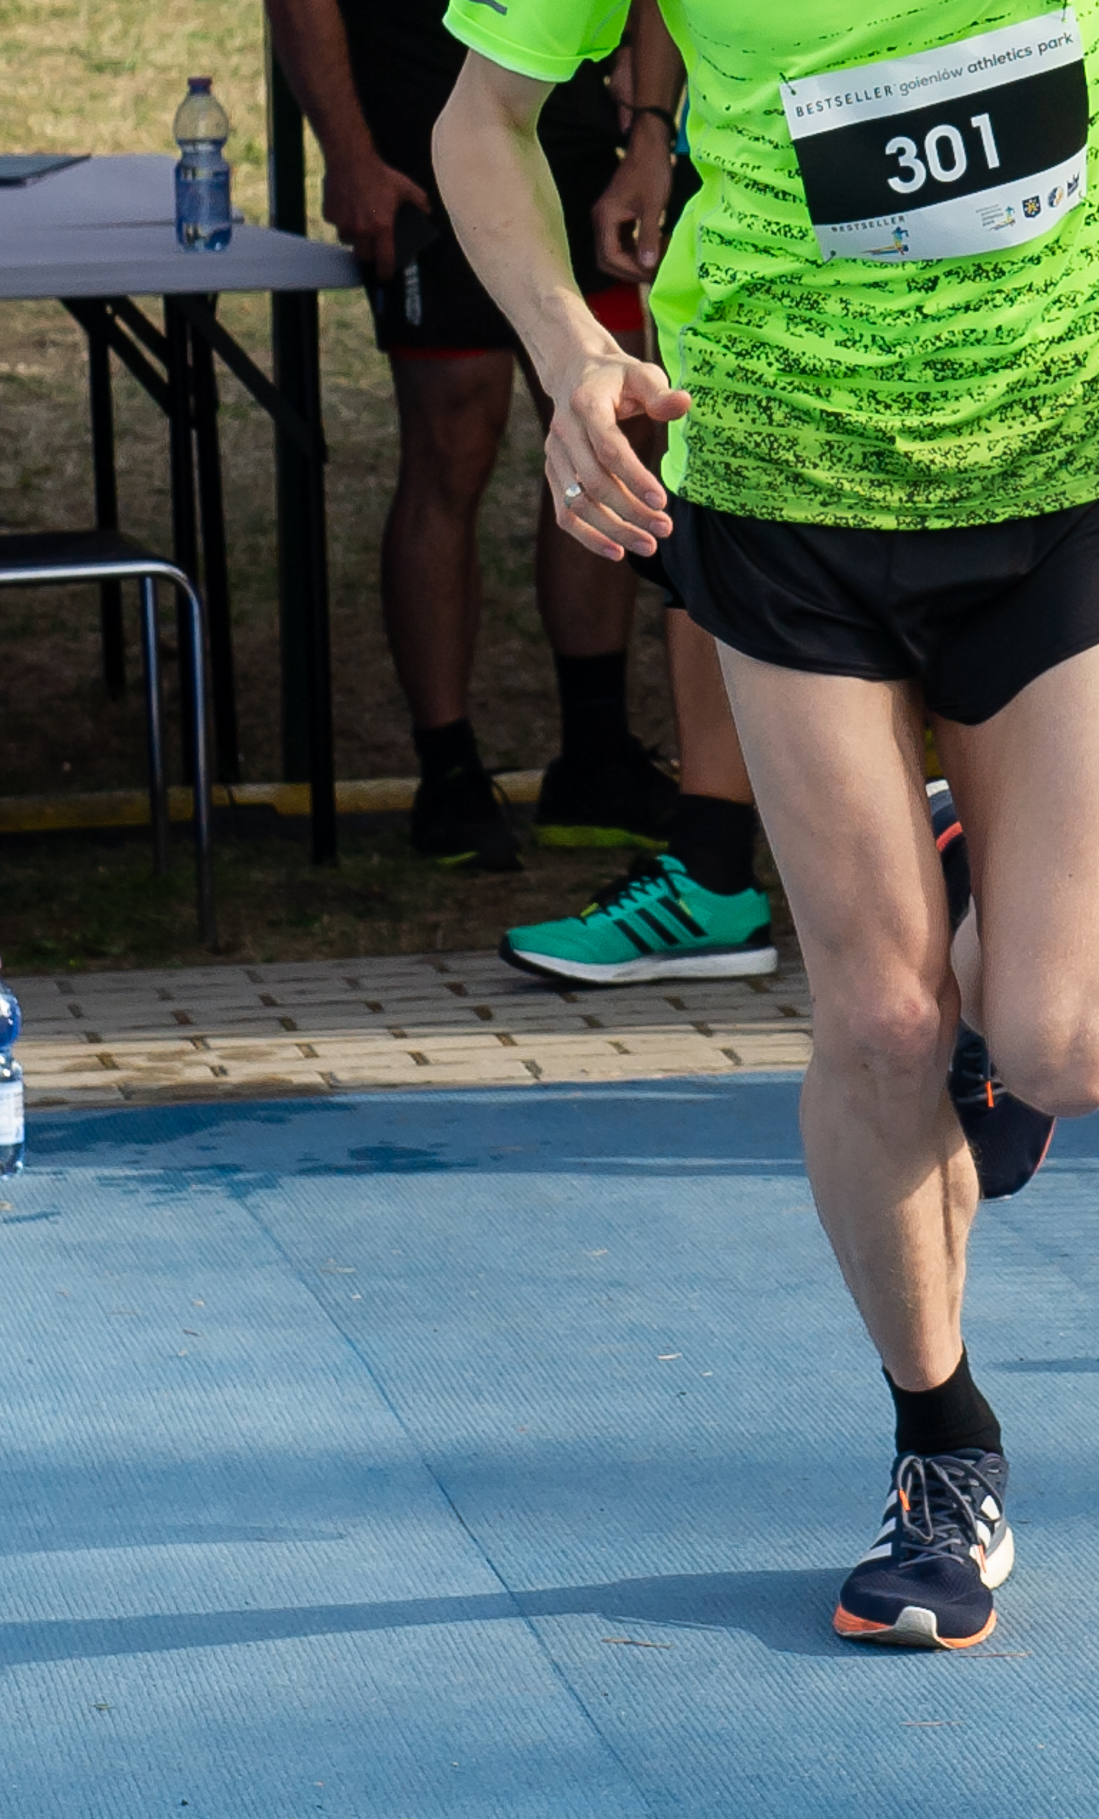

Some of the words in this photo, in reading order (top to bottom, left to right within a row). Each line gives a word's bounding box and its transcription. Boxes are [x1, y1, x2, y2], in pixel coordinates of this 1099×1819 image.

[795, 85, 894, 118] BESTSELLER
[967, 46, 1034, 74] athletics
[1038, 31, 1075, 57] park
[884, 113, 1001, 195] 301
